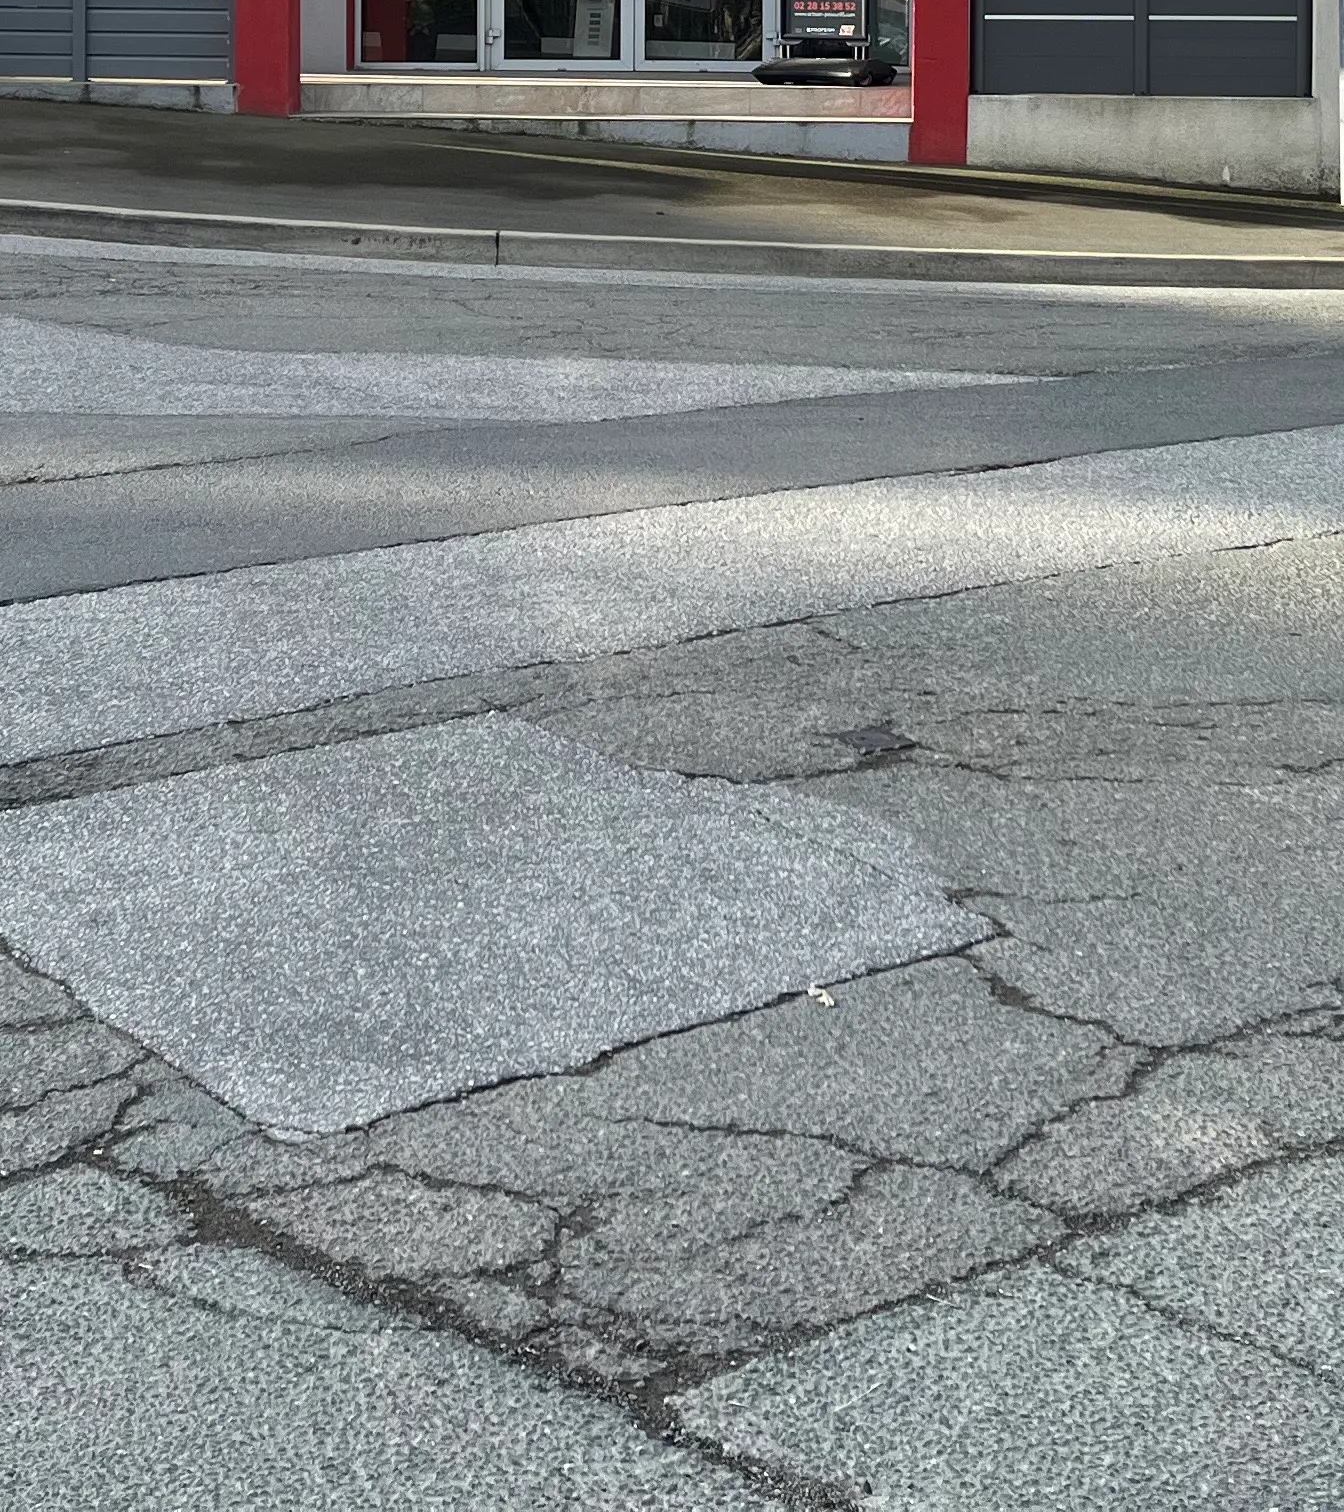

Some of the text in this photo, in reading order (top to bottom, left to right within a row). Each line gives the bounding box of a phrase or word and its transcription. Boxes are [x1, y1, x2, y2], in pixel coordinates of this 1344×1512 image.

[794, 1, 805, 10] 02
[820, 1, 830, 10] 15
[845, 1, 856, 10] 52
